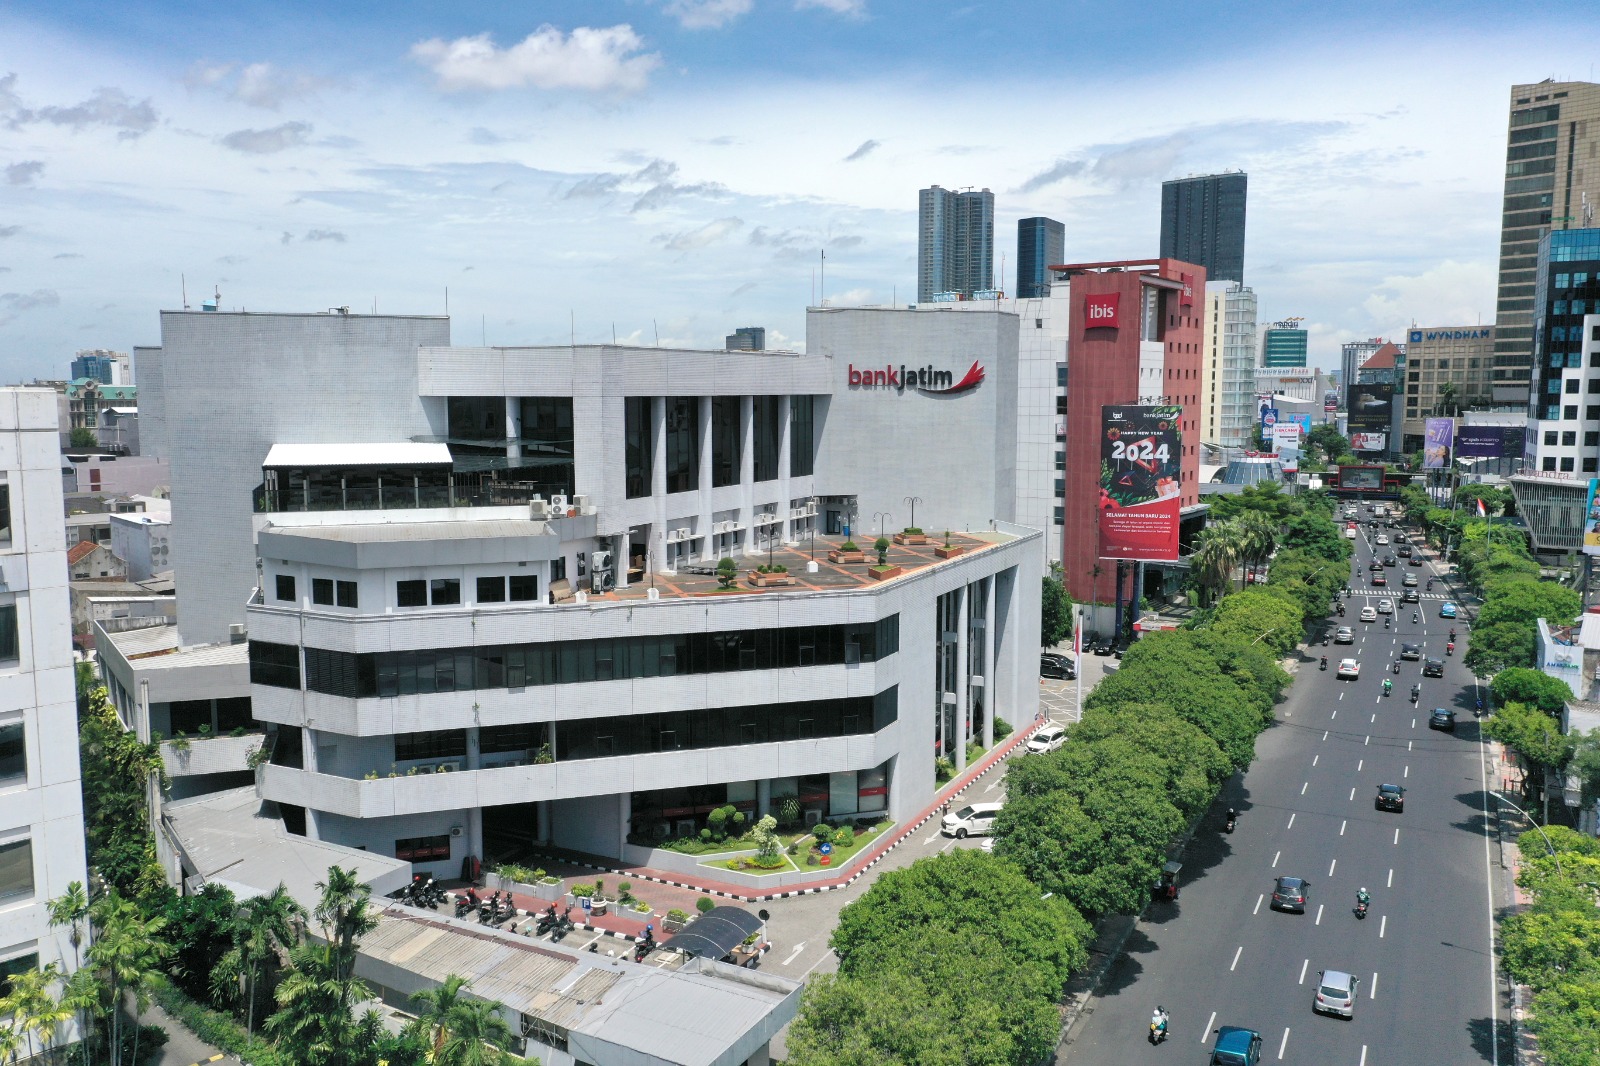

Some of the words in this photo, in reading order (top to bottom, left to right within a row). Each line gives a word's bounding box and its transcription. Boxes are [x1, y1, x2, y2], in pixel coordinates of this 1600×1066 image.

[1183, 284, 1192, 297] ibis
[1090, 303, 1114, 319] ibis
[1427, 330, 1490, 340] WYNDHAM
[848, 363, 953, 391] bankjatim
[1111, 440, 1170, 464] 2024
